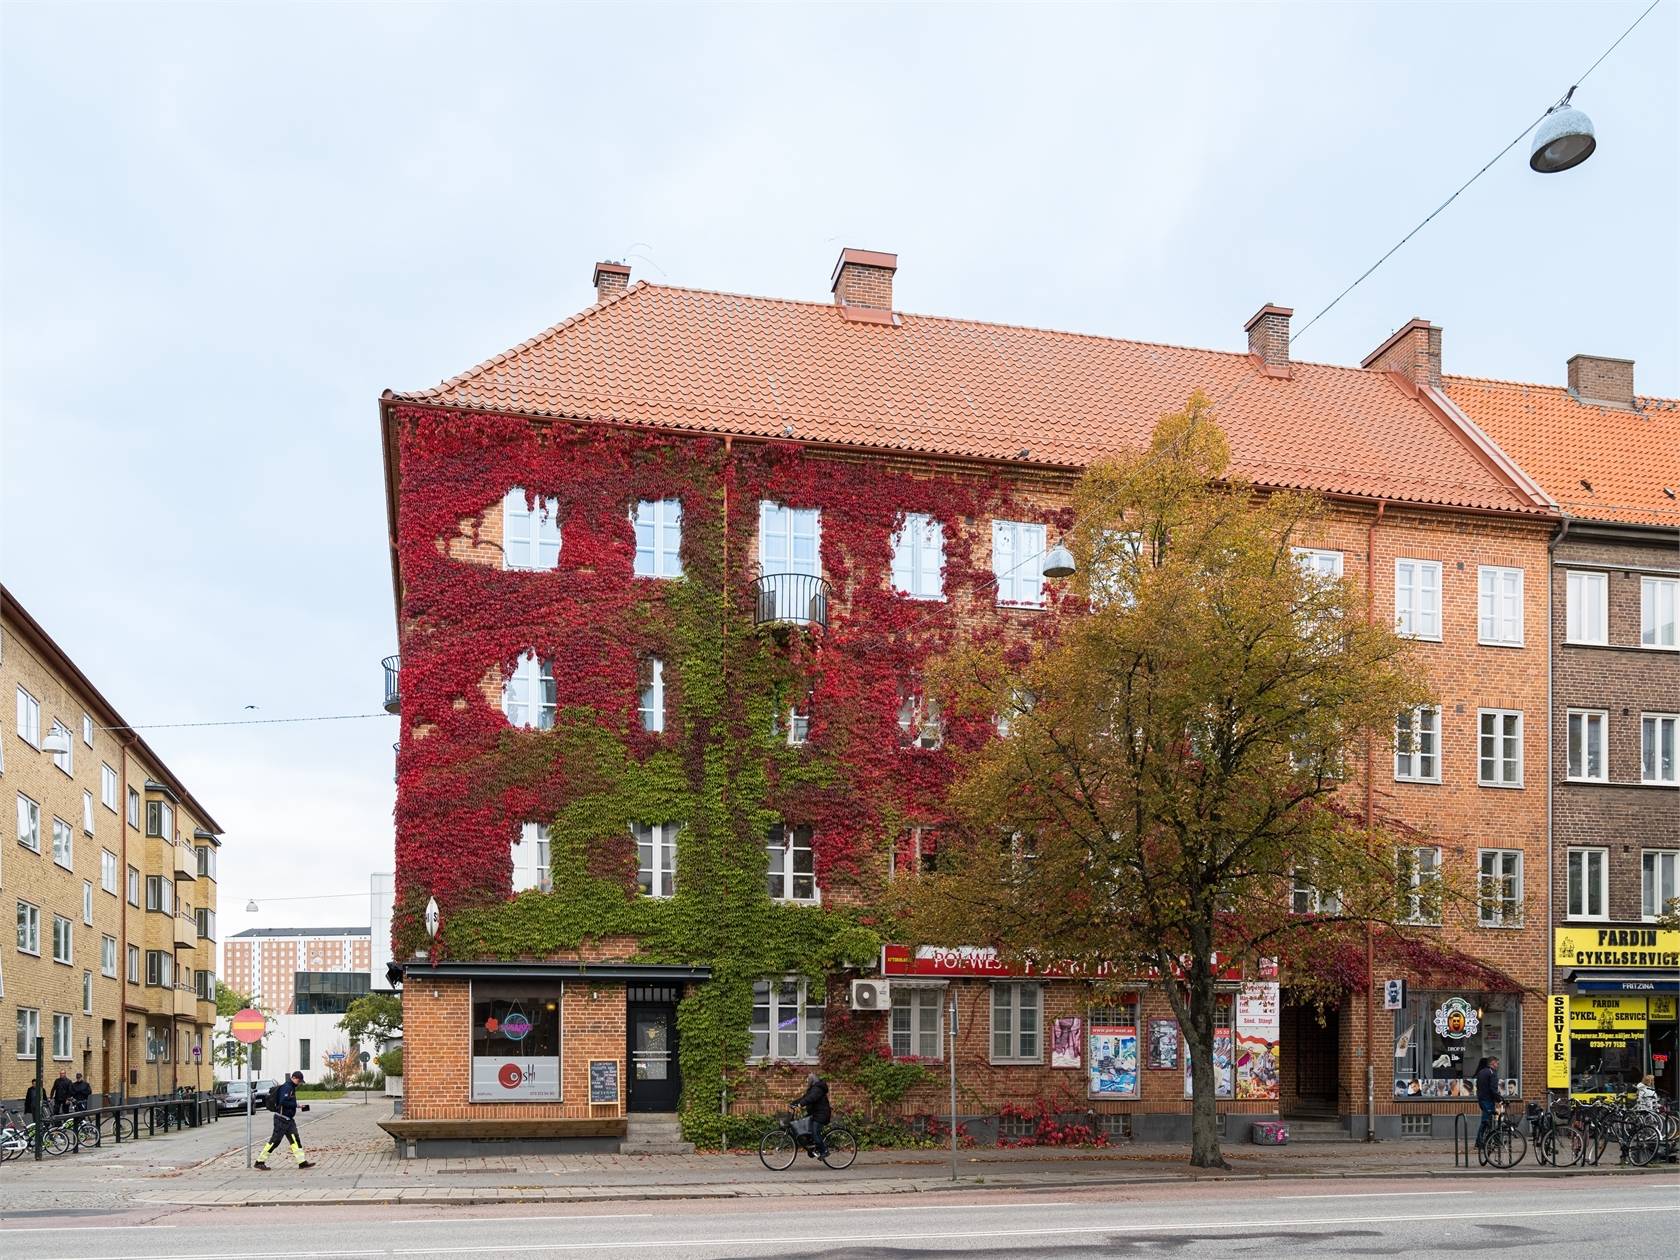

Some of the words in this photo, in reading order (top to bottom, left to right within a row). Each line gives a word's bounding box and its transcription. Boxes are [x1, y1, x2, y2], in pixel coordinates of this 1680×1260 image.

[1598, 930, 1657, 947] FARDIN
[1576, 951, 1679, 965] CYKELSERVICE
[1592, 1000, 1620, 1008] FARDIN
[1570, 1011, 1597, 1020] CYKEL
[1615, 1012, 1646, 1021] SERVICE
[1554, 997, 1564, 1060] SERVICE
